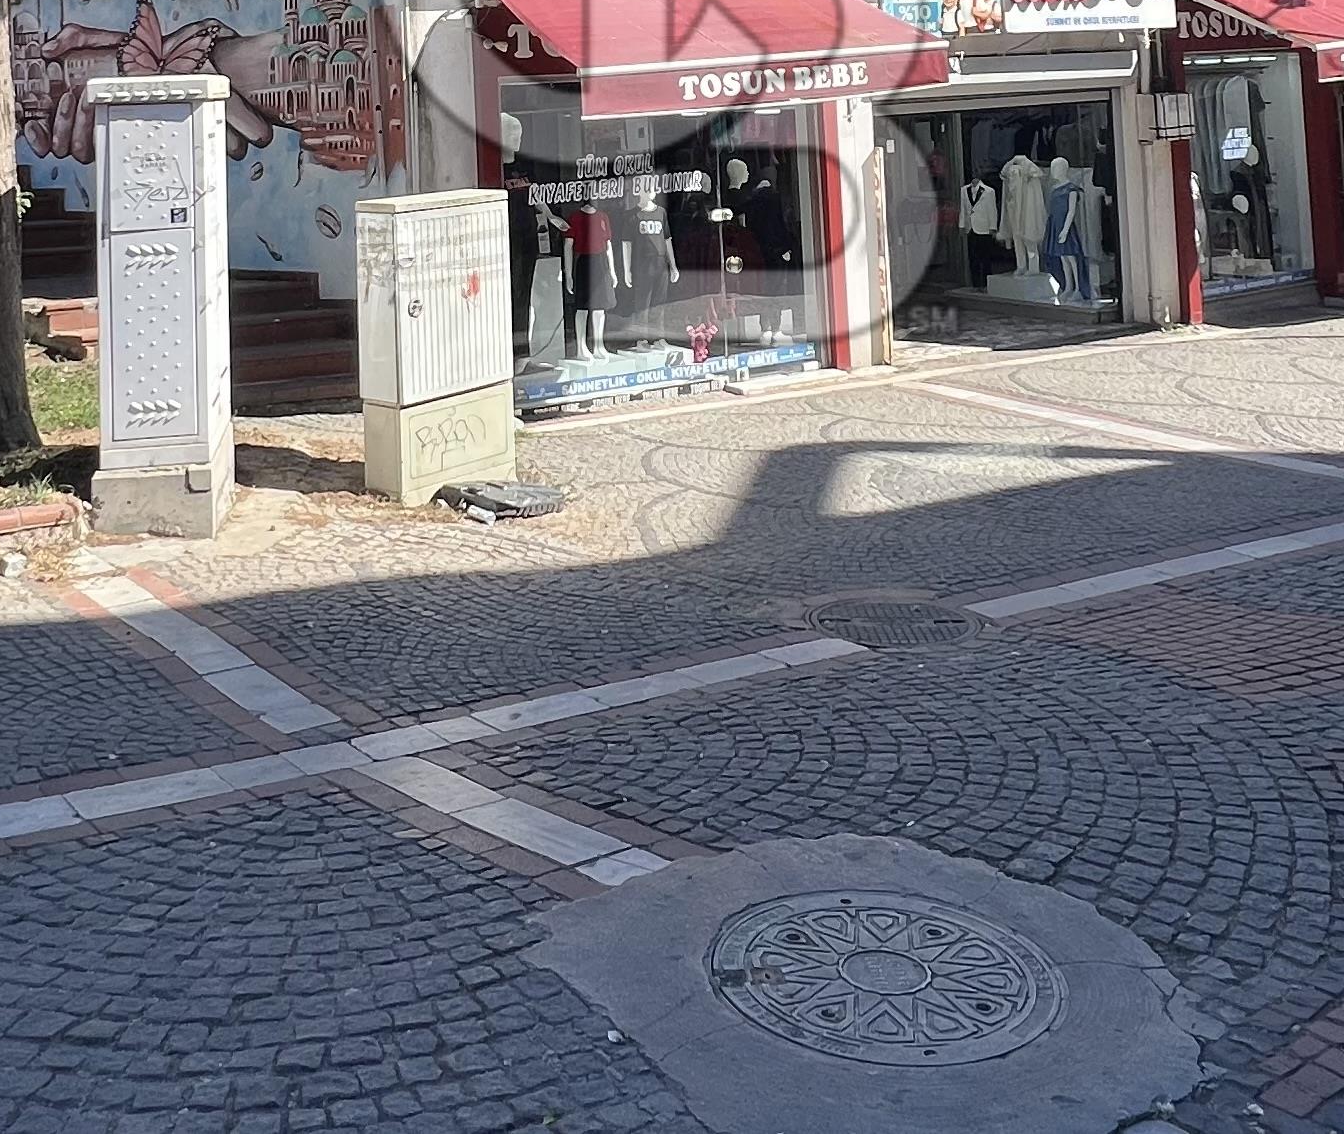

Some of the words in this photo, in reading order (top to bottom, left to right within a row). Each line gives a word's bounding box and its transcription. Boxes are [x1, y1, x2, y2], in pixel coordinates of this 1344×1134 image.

[898, 4, 932, 22] %10
[679, 67, 787, 101] TOSUN
[792, 62, 869, 92] BEBE
[576, 154, 607, 179] TÜM
[613, 153, 654, 174] OKUL
[632, 170, 703, 196] BULUNUR
[637, 369, 668, 382] OKUL
